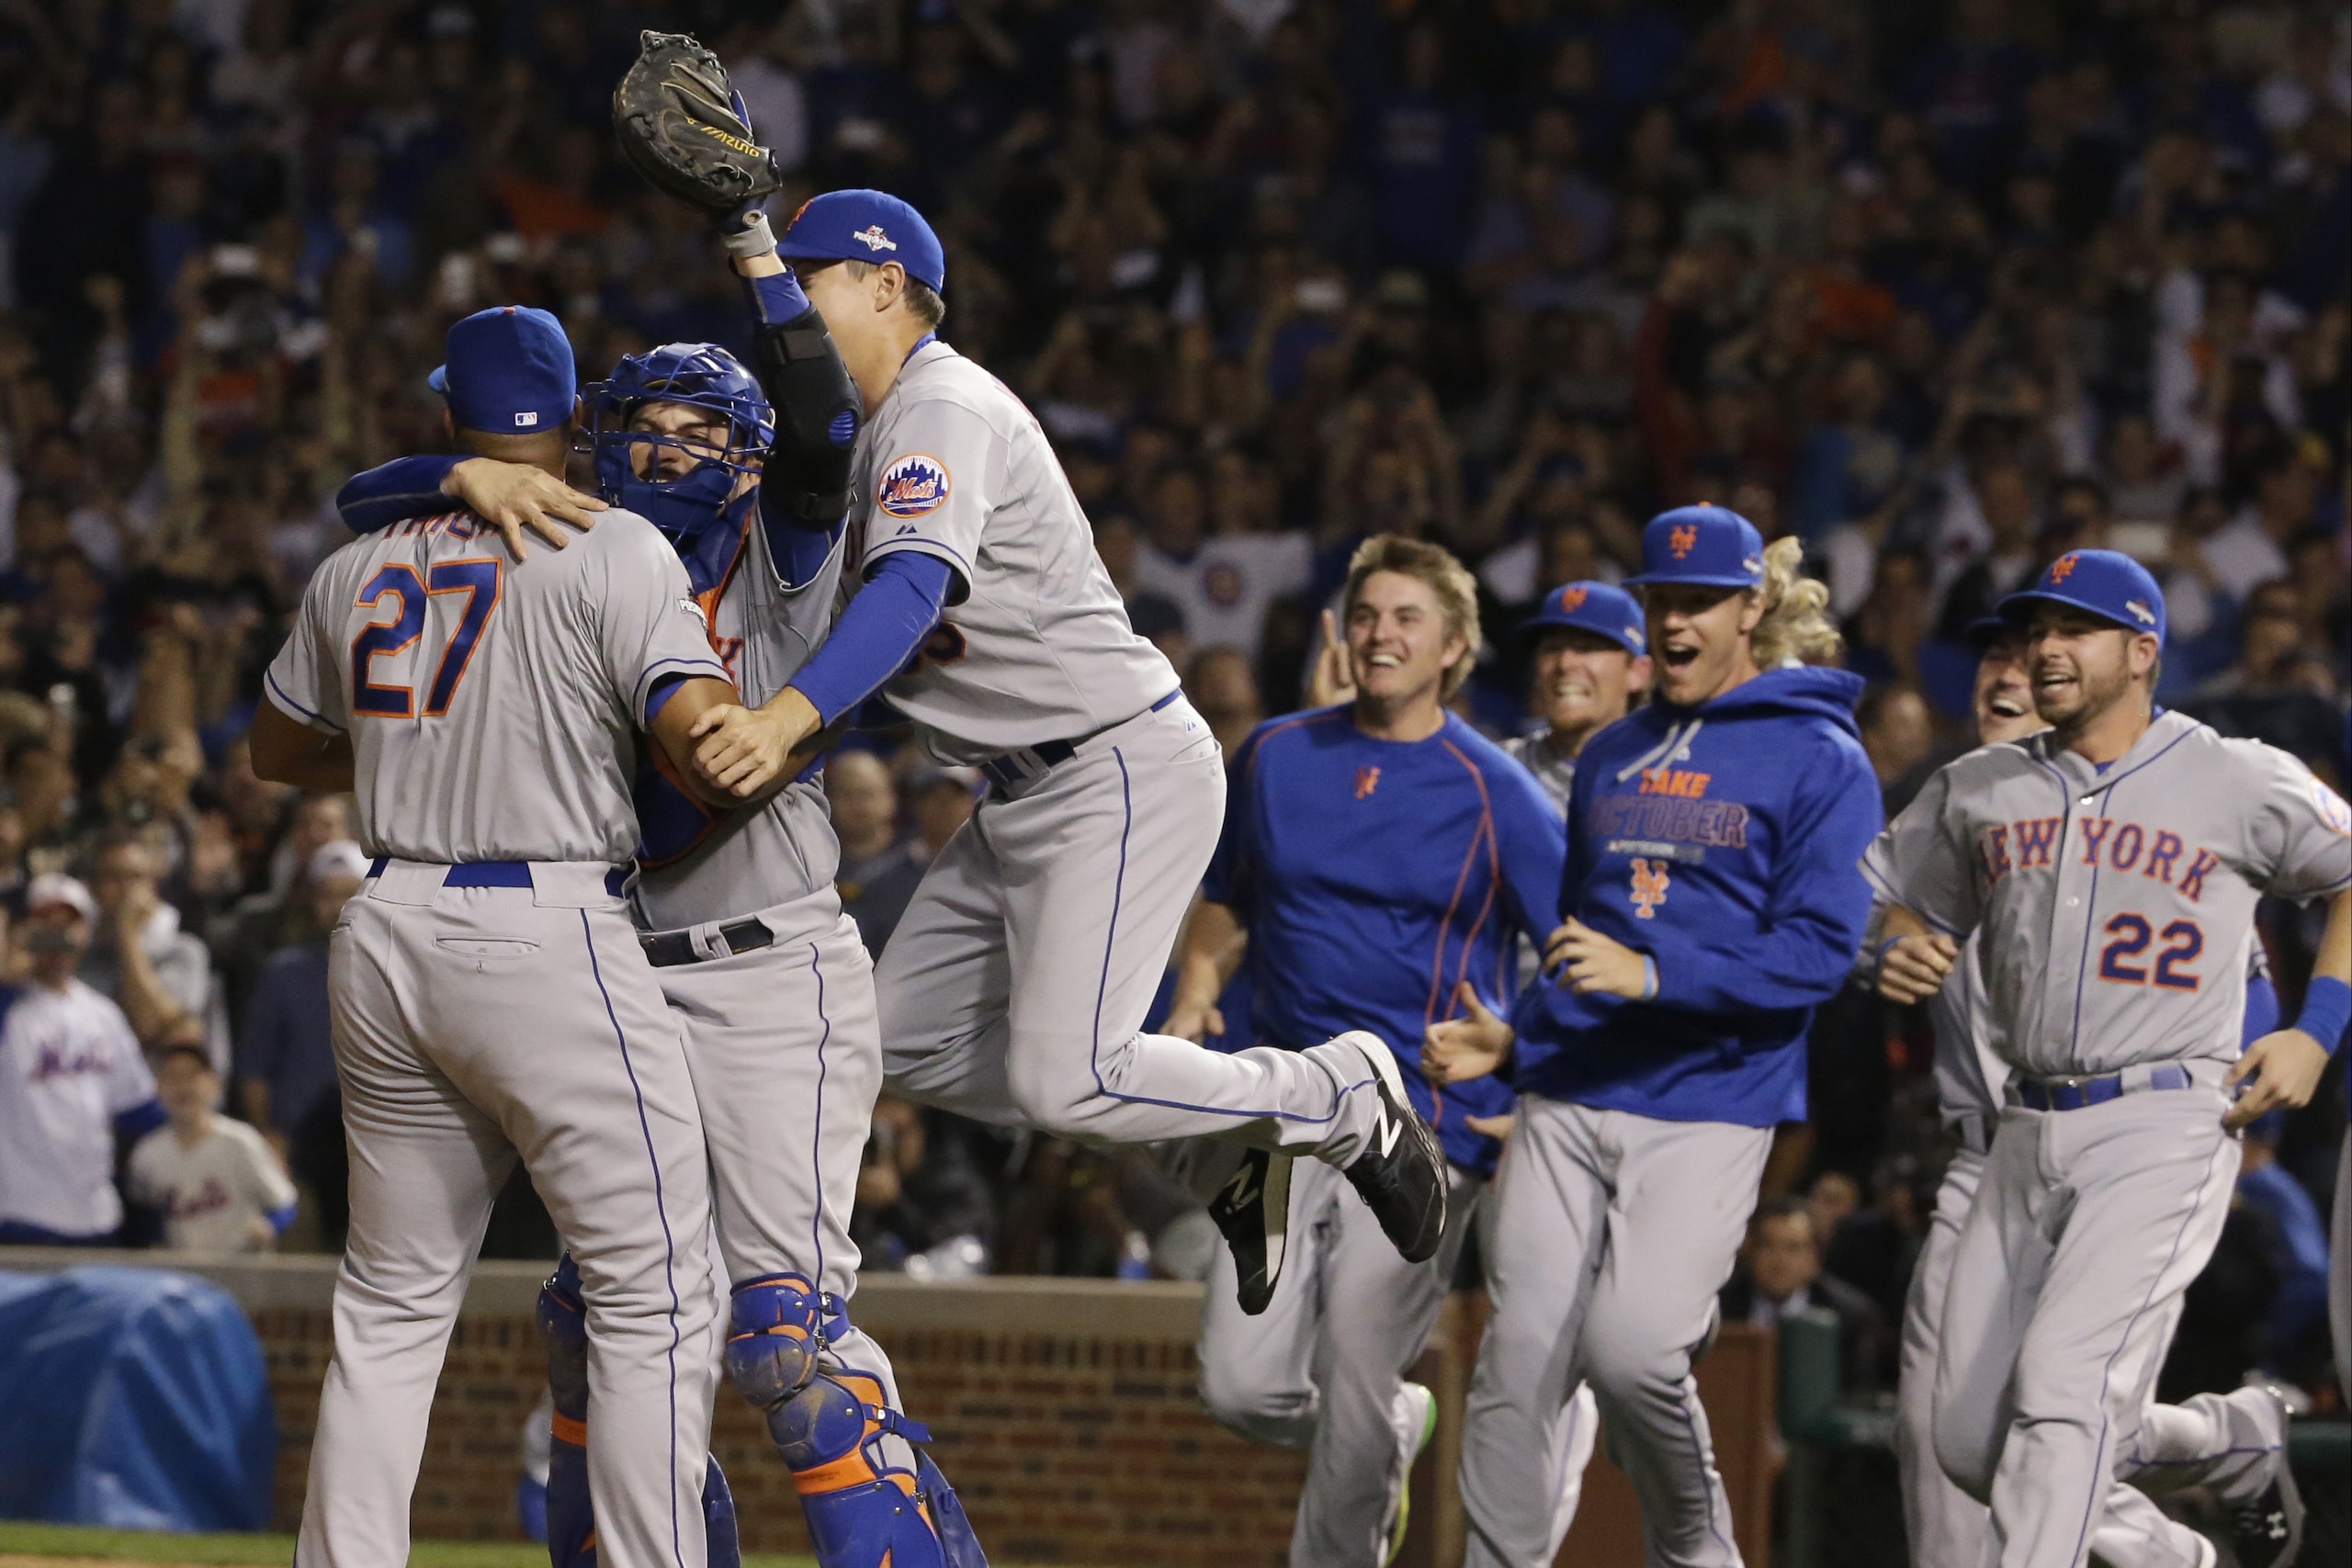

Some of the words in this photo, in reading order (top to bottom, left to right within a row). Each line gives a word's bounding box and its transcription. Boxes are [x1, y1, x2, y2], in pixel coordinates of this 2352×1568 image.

[700, 126, 761, 157] MIZUNO
[887, 477, 938, 502] Mets
[352, 557, 503, 718] 27
[1638, 769, 1712, 798] TAKE
[2079, 818, 2219, 902] YORK
[2098, 912, 2204, 992] 22
